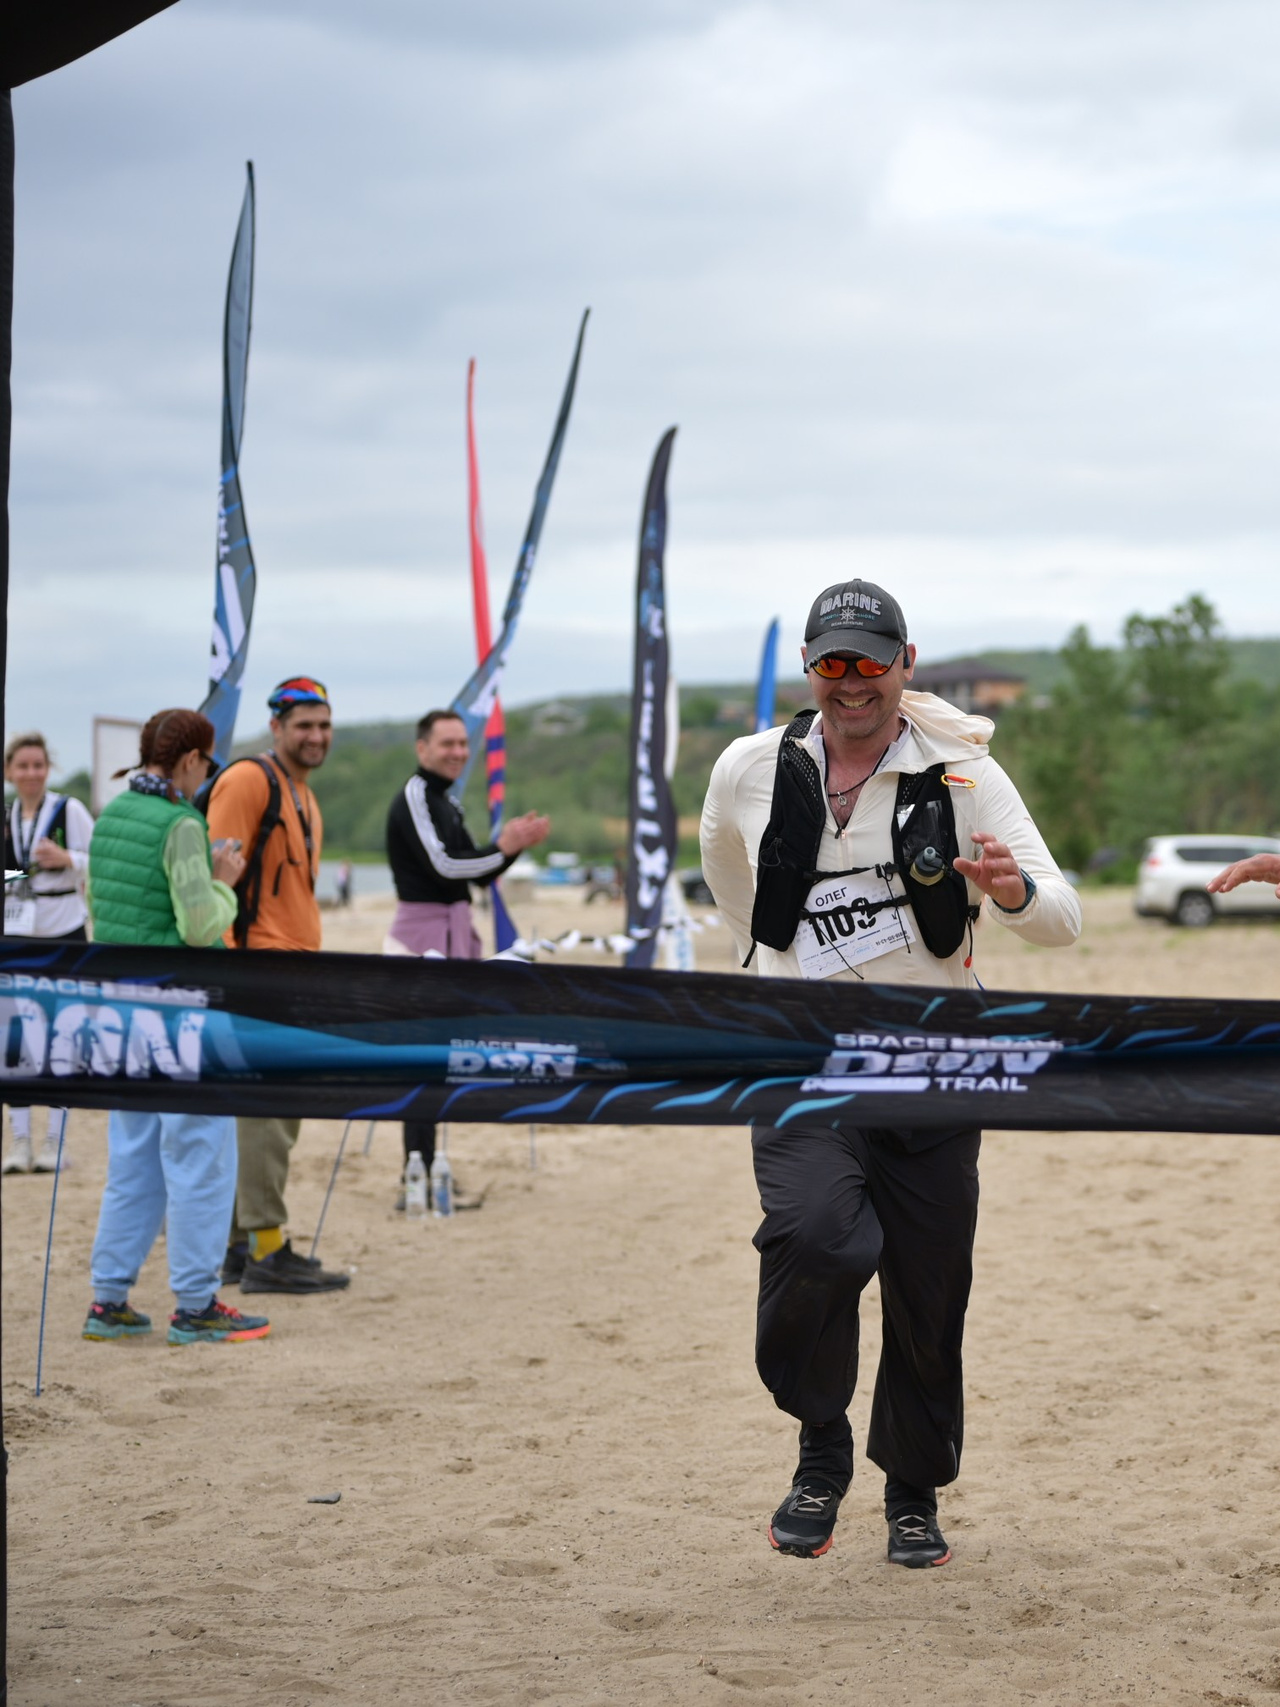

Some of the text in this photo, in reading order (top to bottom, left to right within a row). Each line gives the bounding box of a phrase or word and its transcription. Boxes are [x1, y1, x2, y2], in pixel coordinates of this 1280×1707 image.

[820, 592, 882, 616] MARINE
[815, 886, 847, 907] ОЛЕГ
[808, 897, 877, 947] 1103
[0, 973, 98, 996] SPACE
[834, 1033, 947, 1050] SPACE
[934, 1076, 1028, 1092] TRAIL
